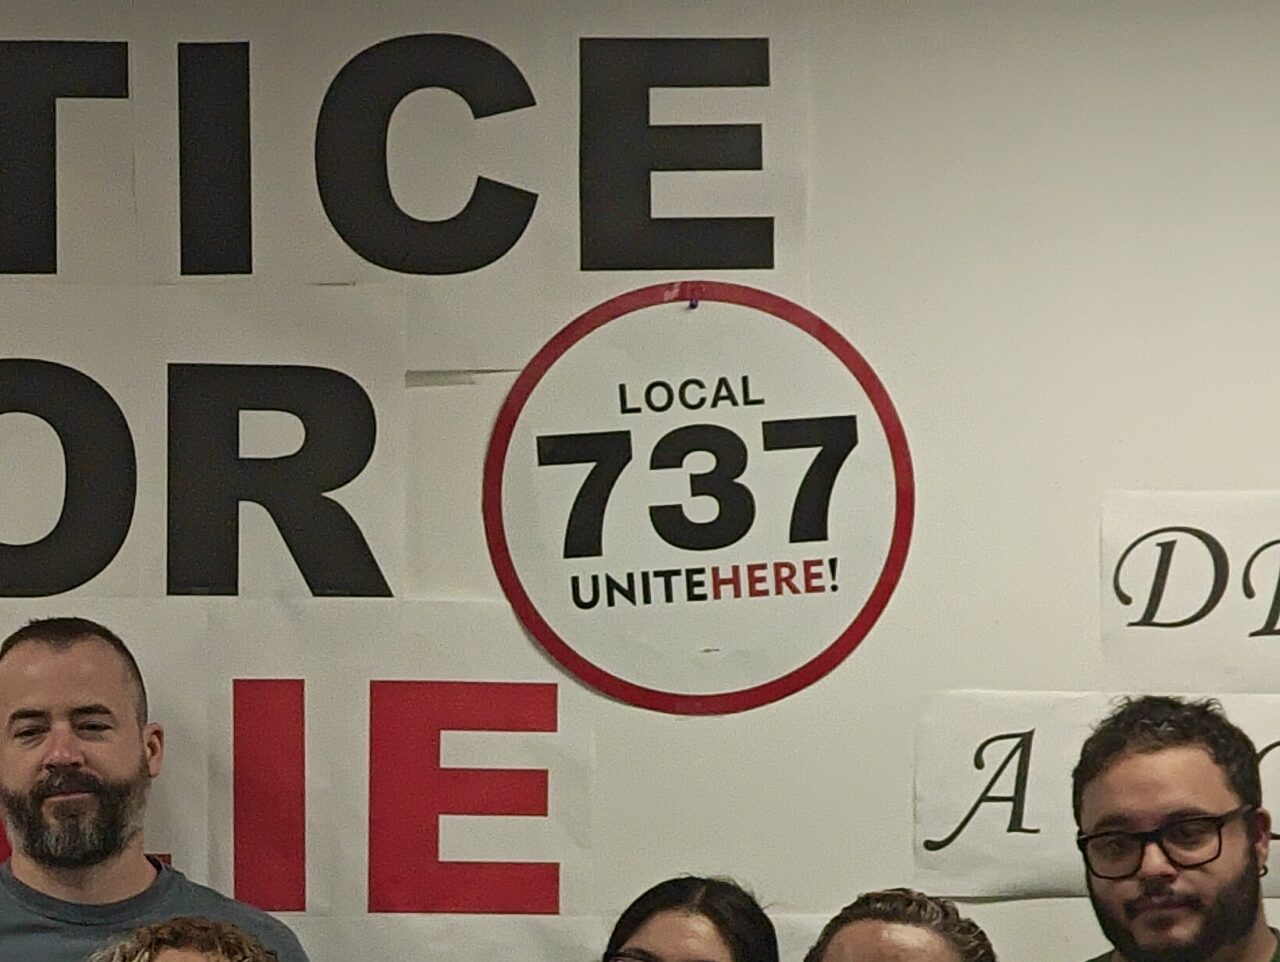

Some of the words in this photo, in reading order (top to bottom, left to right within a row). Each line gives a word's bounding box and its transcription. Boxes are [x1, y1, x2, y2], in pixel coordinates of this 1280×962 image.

[618, 375, 765, 415] LOCAL
[535, 414, 859, 560] 737
[570, 557, 840, 610] UNITEHERE!
